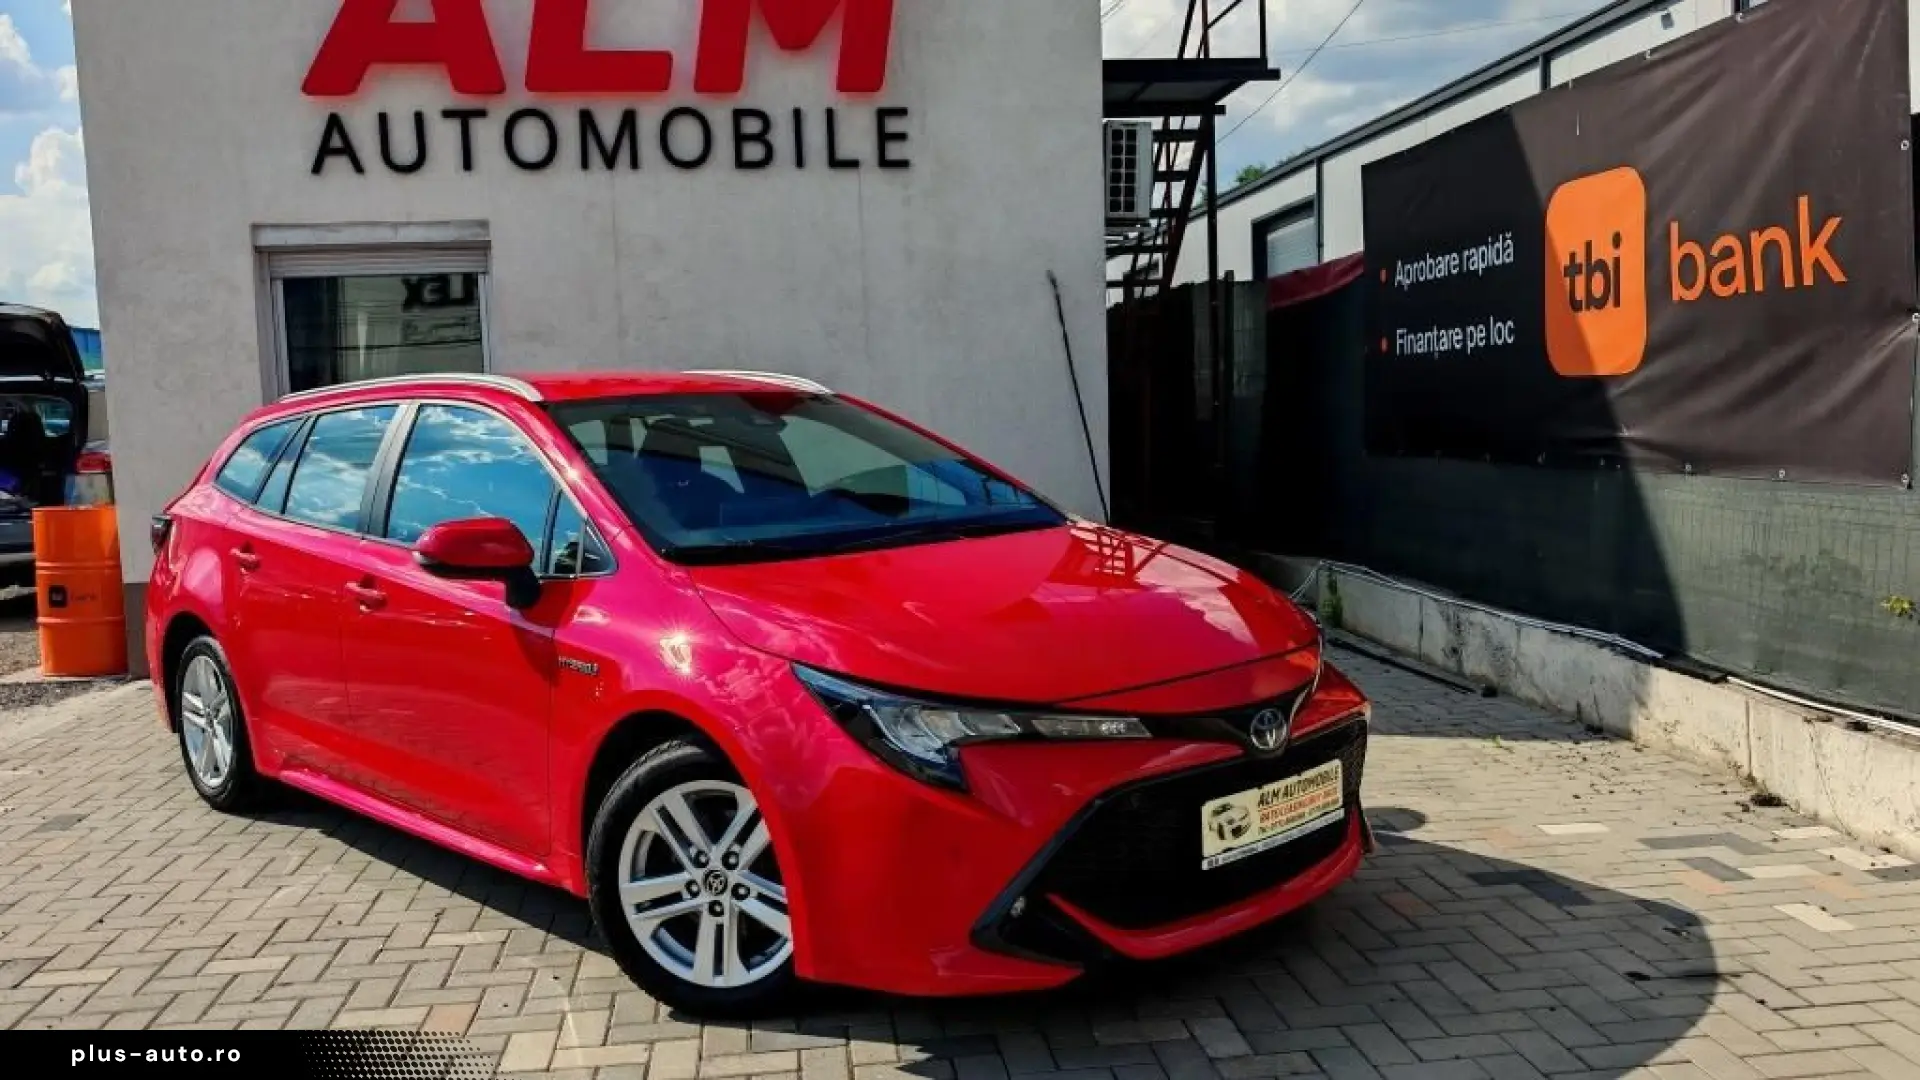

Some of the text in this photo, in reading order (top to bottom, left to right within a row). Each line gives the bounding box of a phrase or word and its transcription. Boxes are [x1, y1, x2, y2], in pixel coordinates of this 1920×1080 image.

[311, 107, 911, 174] AUTOMOBILE
[1394, 231, 1514, 291] Aprobare rapidă
[1563, 194, 1848, 312] tbi bank
[1396, 314, 1515, 360] Finanțare pe loc
